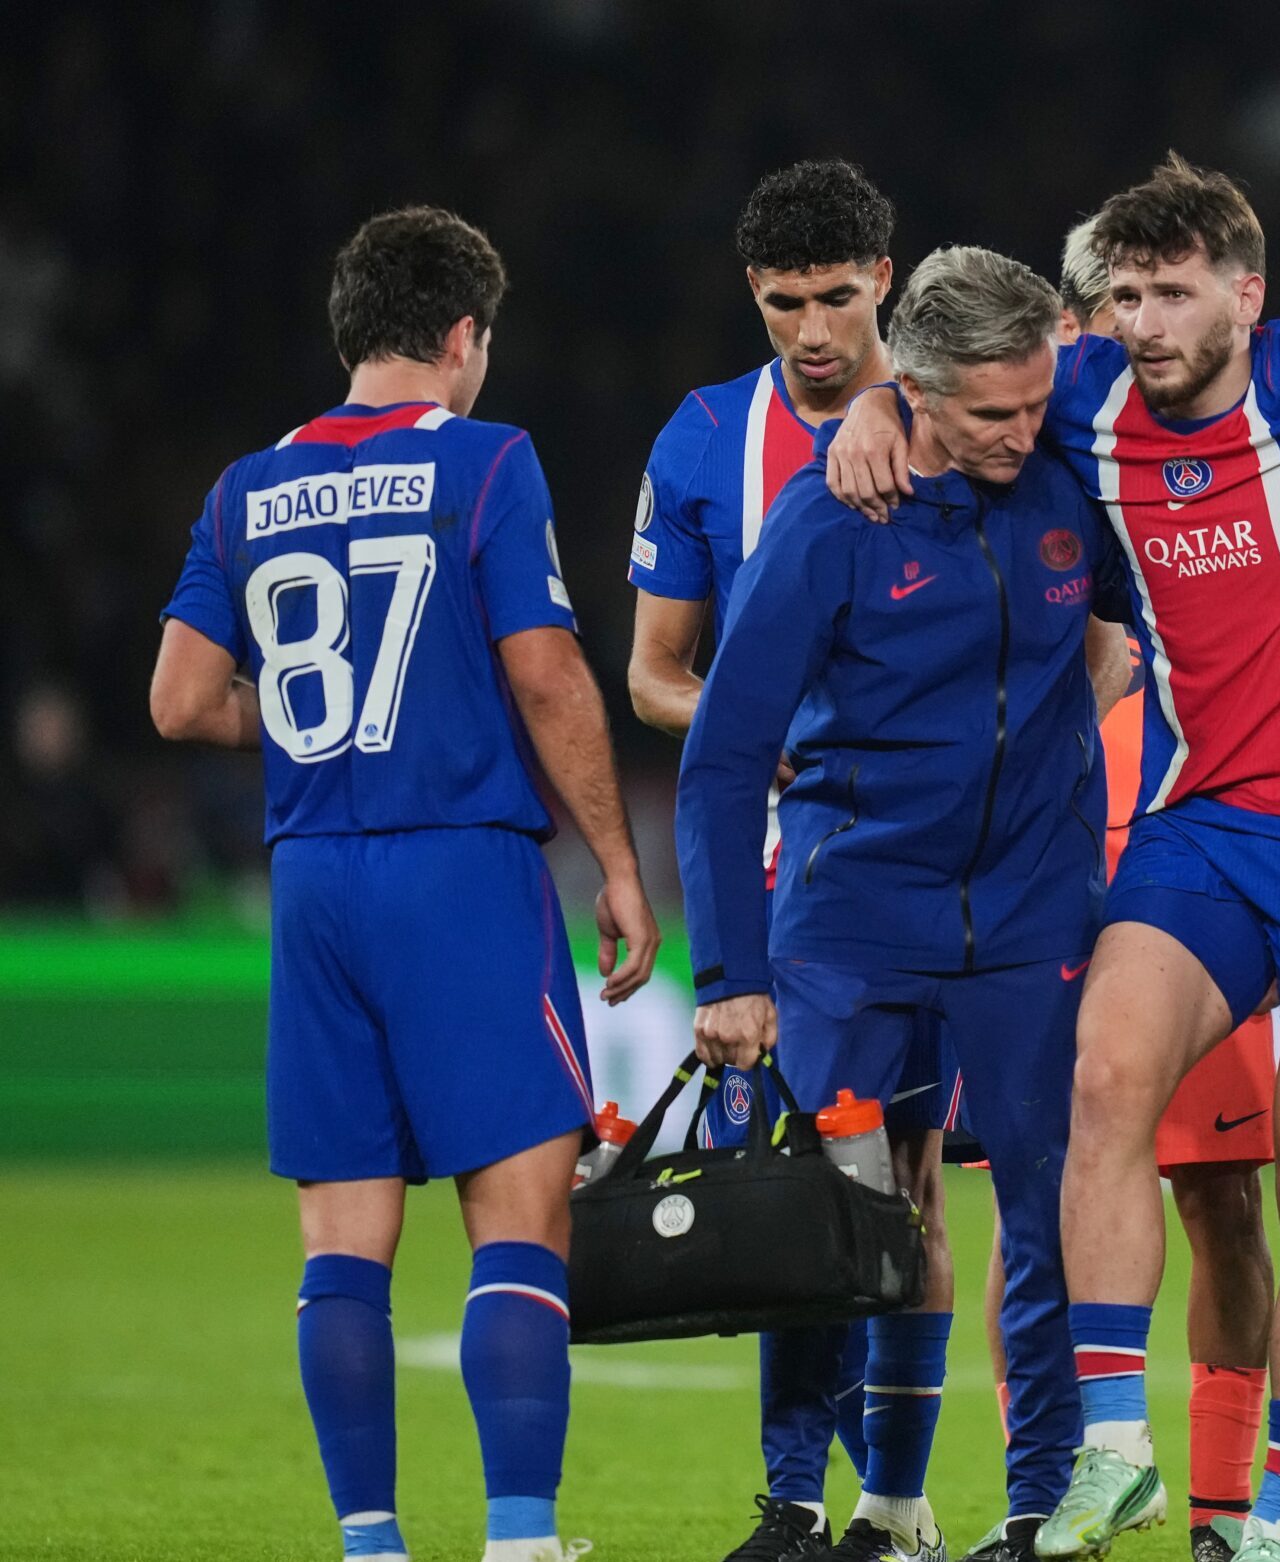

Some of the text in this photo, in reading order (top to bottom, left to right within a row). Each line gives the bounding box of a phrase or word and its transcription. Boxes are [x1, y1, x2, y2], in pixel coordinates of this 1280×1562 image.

[255, 475, 426, 531] JOÃO EVES
[1144, 520, 1258, 568] QATAR
[1178, 547, 1262, 578] AIRWAYS
[245, 534, 437, 764] 87
